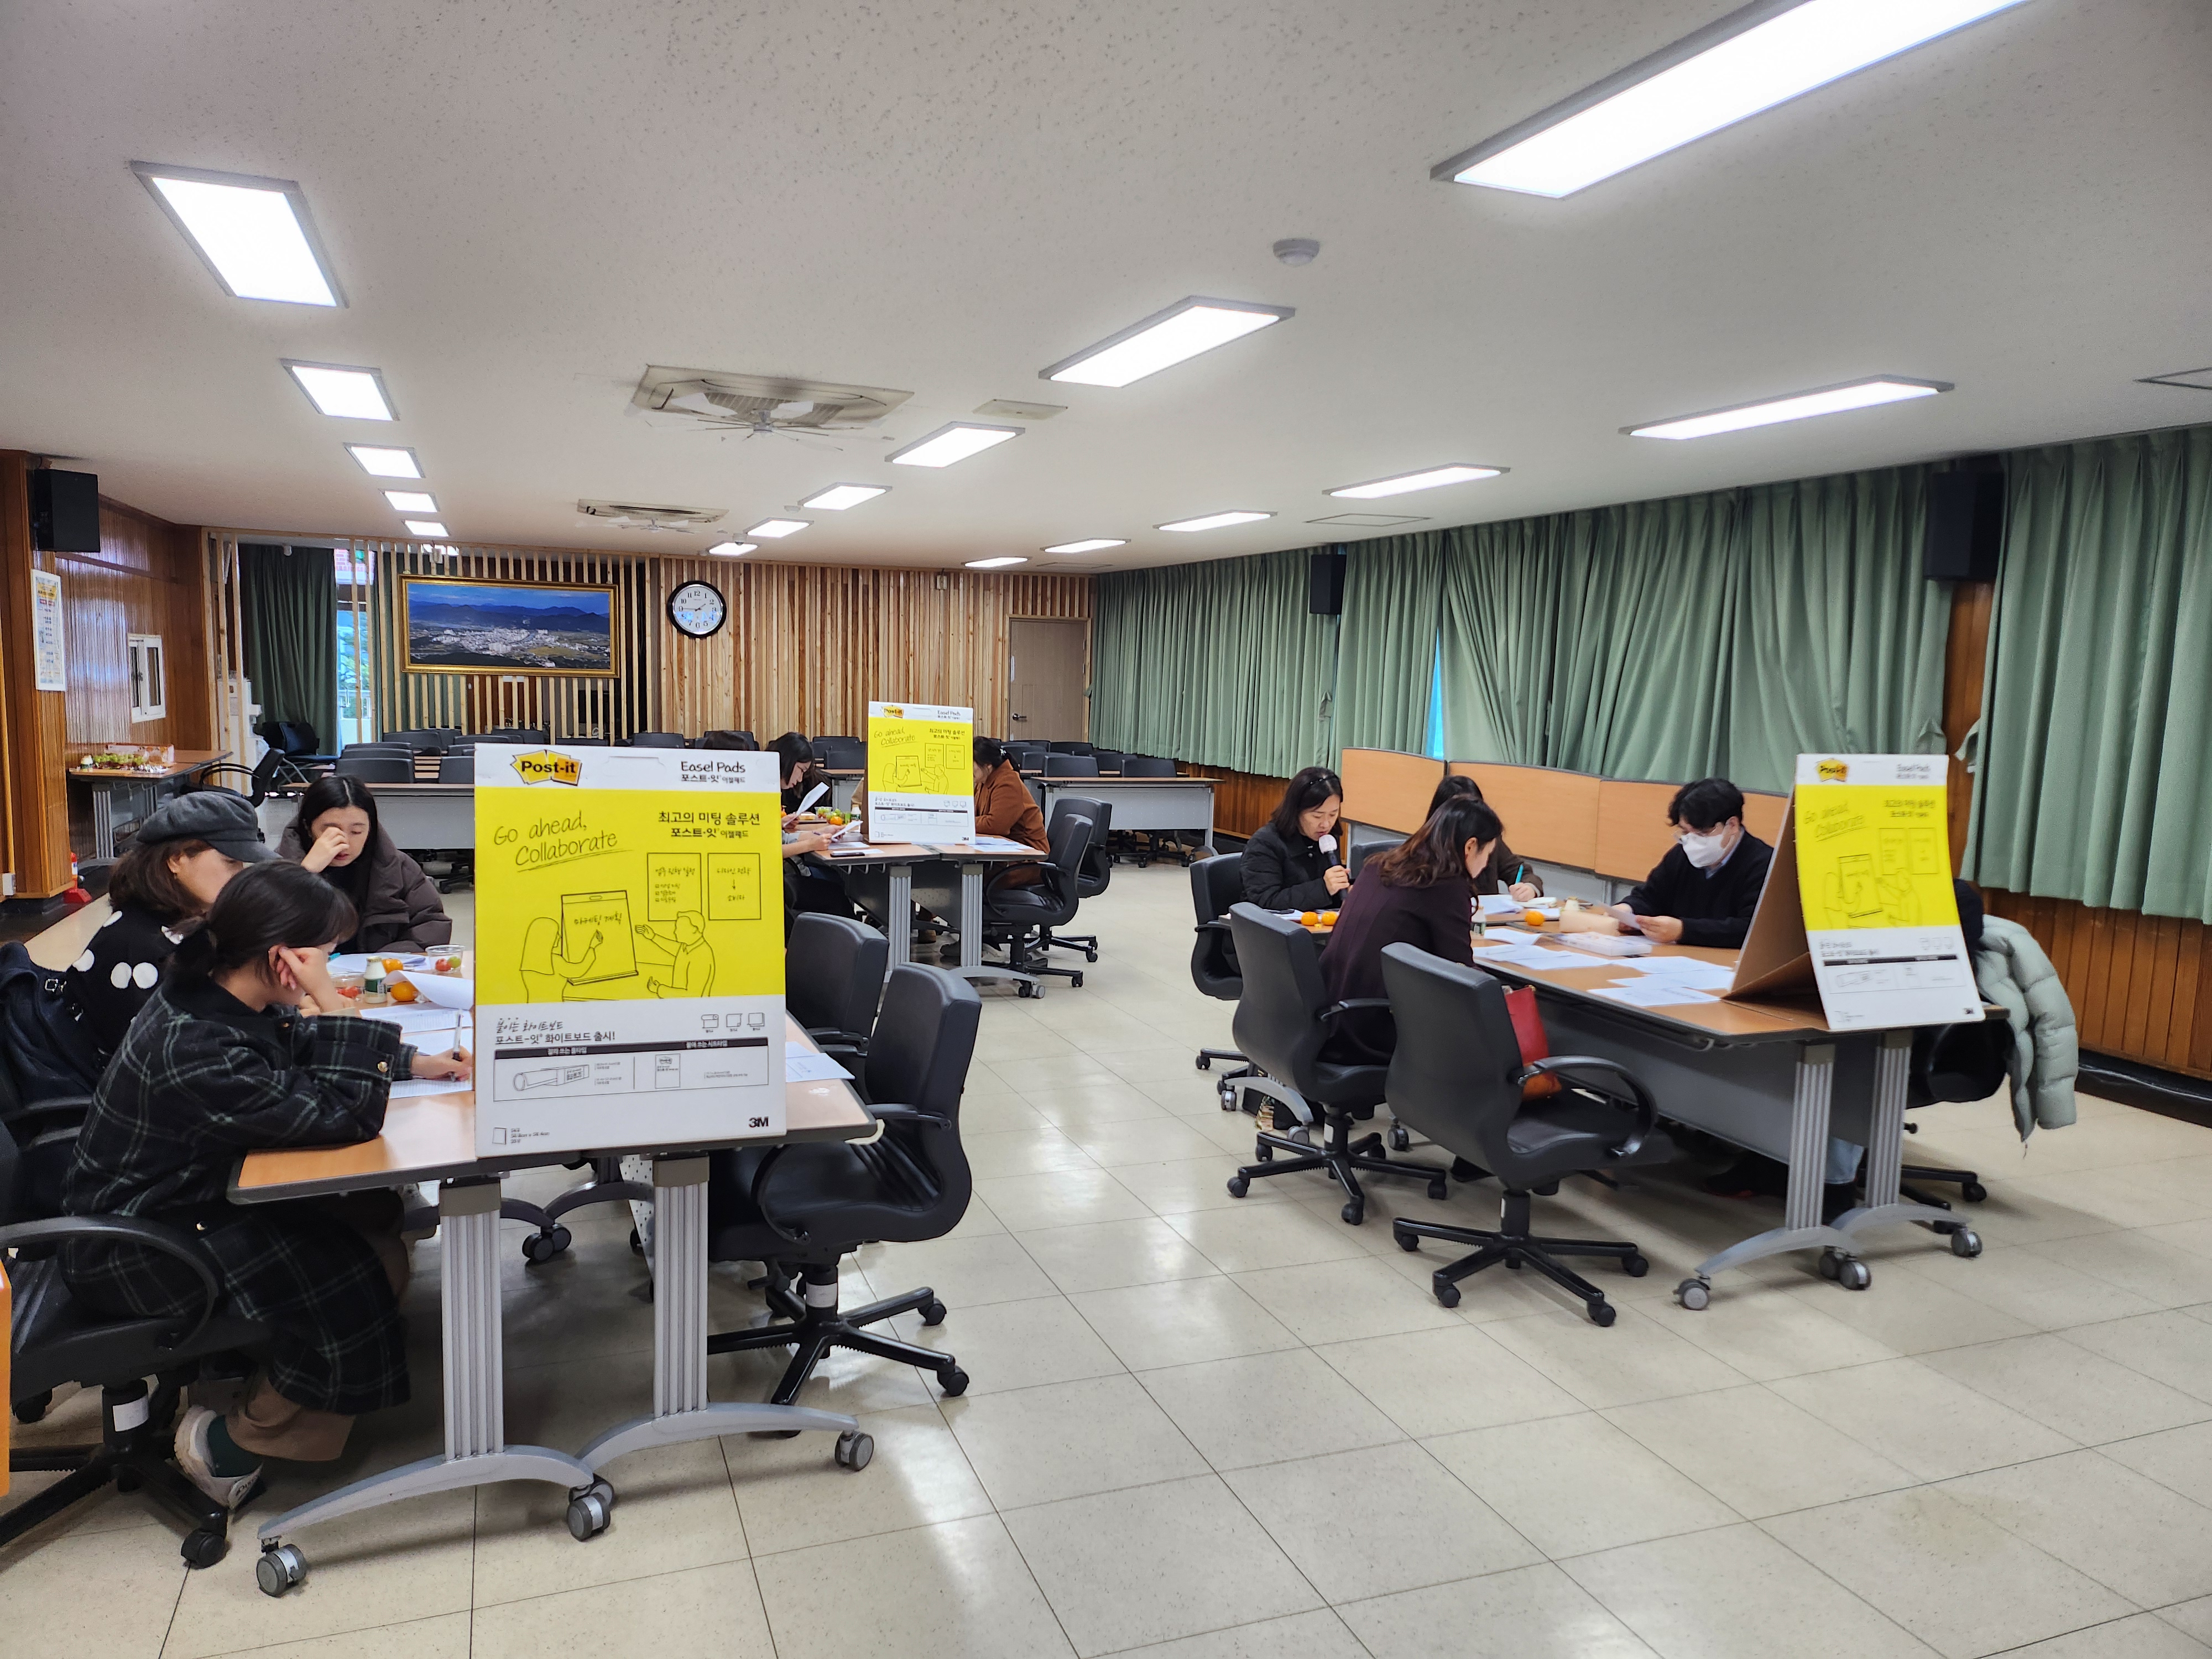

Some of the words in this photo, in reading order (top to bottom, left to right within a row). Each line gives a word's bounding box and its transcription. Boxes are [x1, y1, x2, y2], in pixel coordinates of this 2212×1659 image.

[521, 760, 576, 774] Post-it
[681, 760, 713, 772] Easel
[717, 761, 746, 773] Pads
[658, 811, 694, 823] 최고의
[698, 812, 721, 826] 미팅
[725, 812, 760, 826] 솔루션
[494, 826, 519, 846] Go
[529, 809, 587, 839] ahead,
[515, 830, 618, 866] Collaborate
[497, 1019, 520, 1034] 붙이는
[522, 1020, 564, 1032] 화이트보드
[545, 1032, 591, 1044] 화이트보드
[593, 1031, 615, 1042] 출시!
[748, 1116, 769, 1128] 3M
